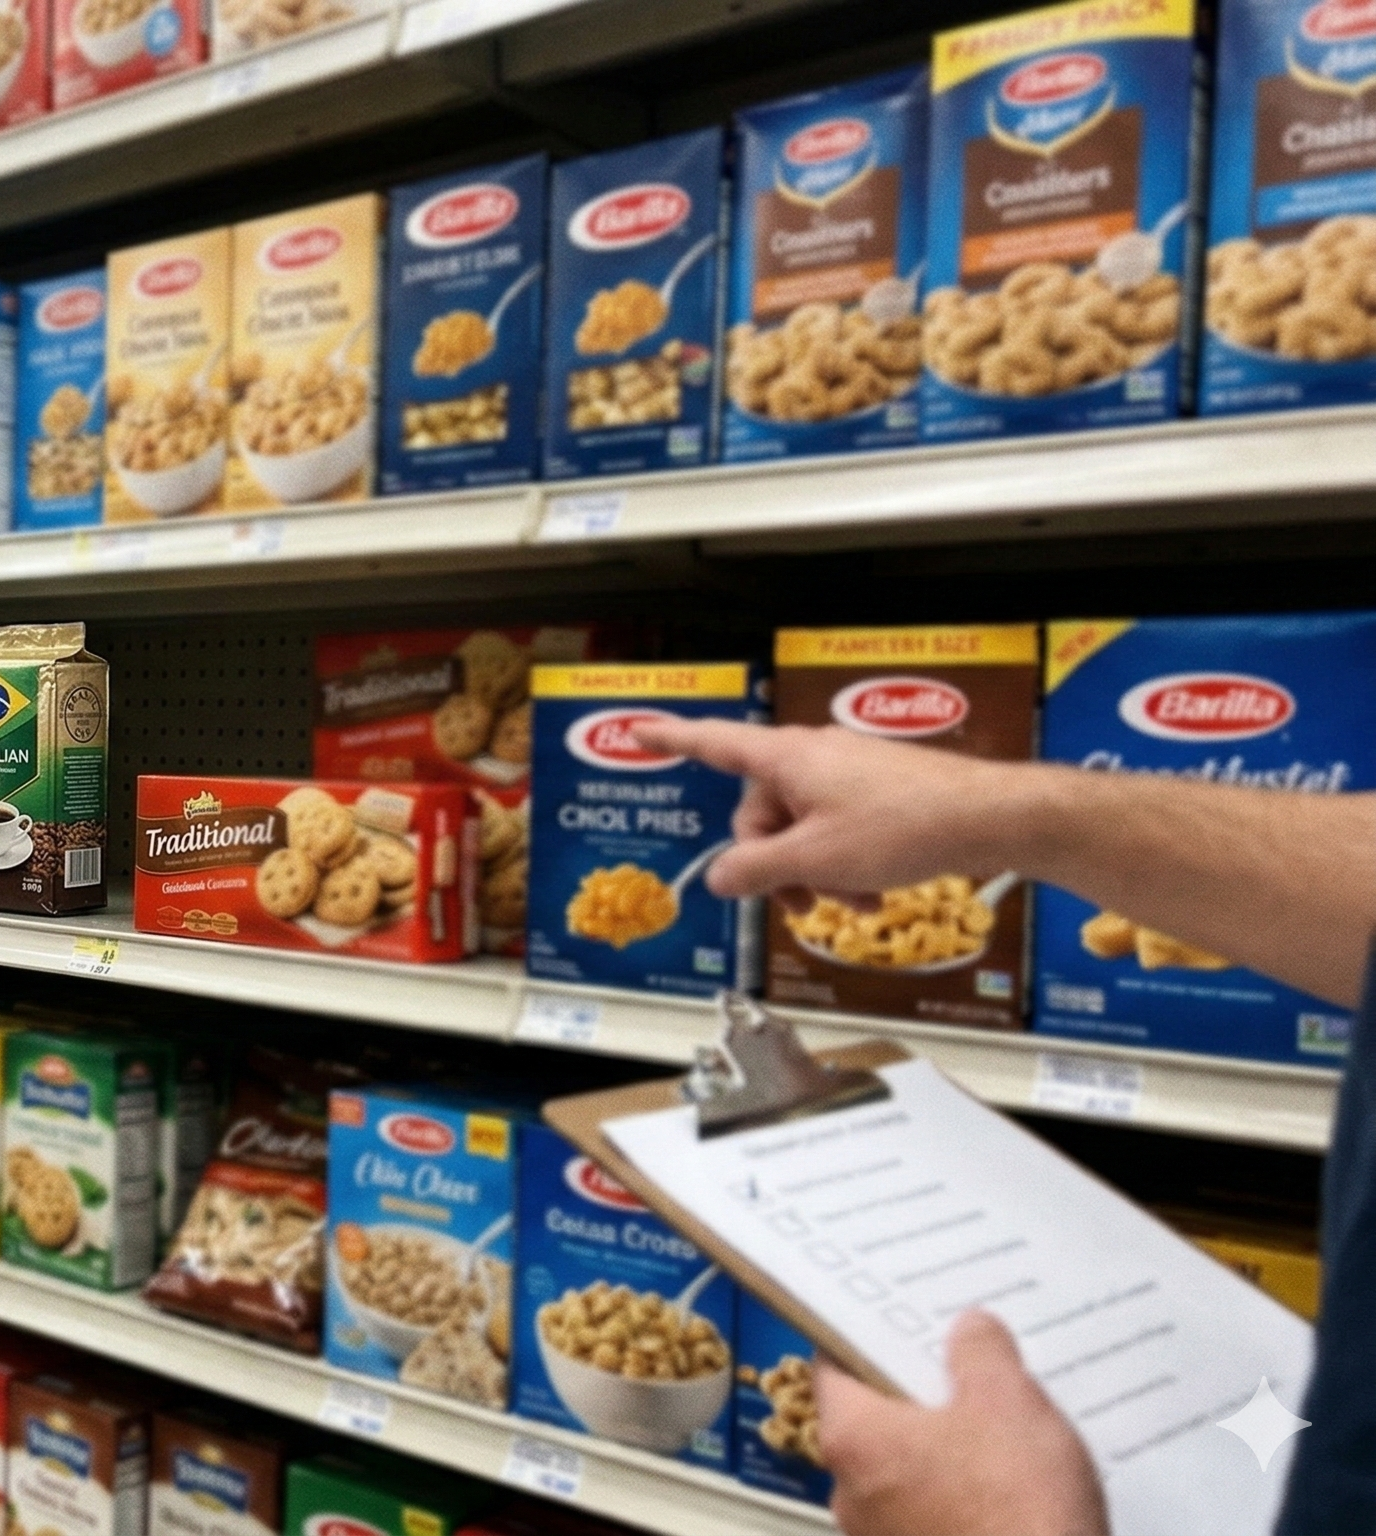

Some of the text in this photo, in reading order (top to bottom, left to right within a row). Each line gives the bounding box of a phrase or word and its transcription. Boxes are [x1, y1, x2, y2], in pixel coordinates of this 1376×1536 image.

[860, 692, 954, 720] Barilla
[1156, 687, 1279, 721] Barilla
[145, 815, 275, 858] Traditional
